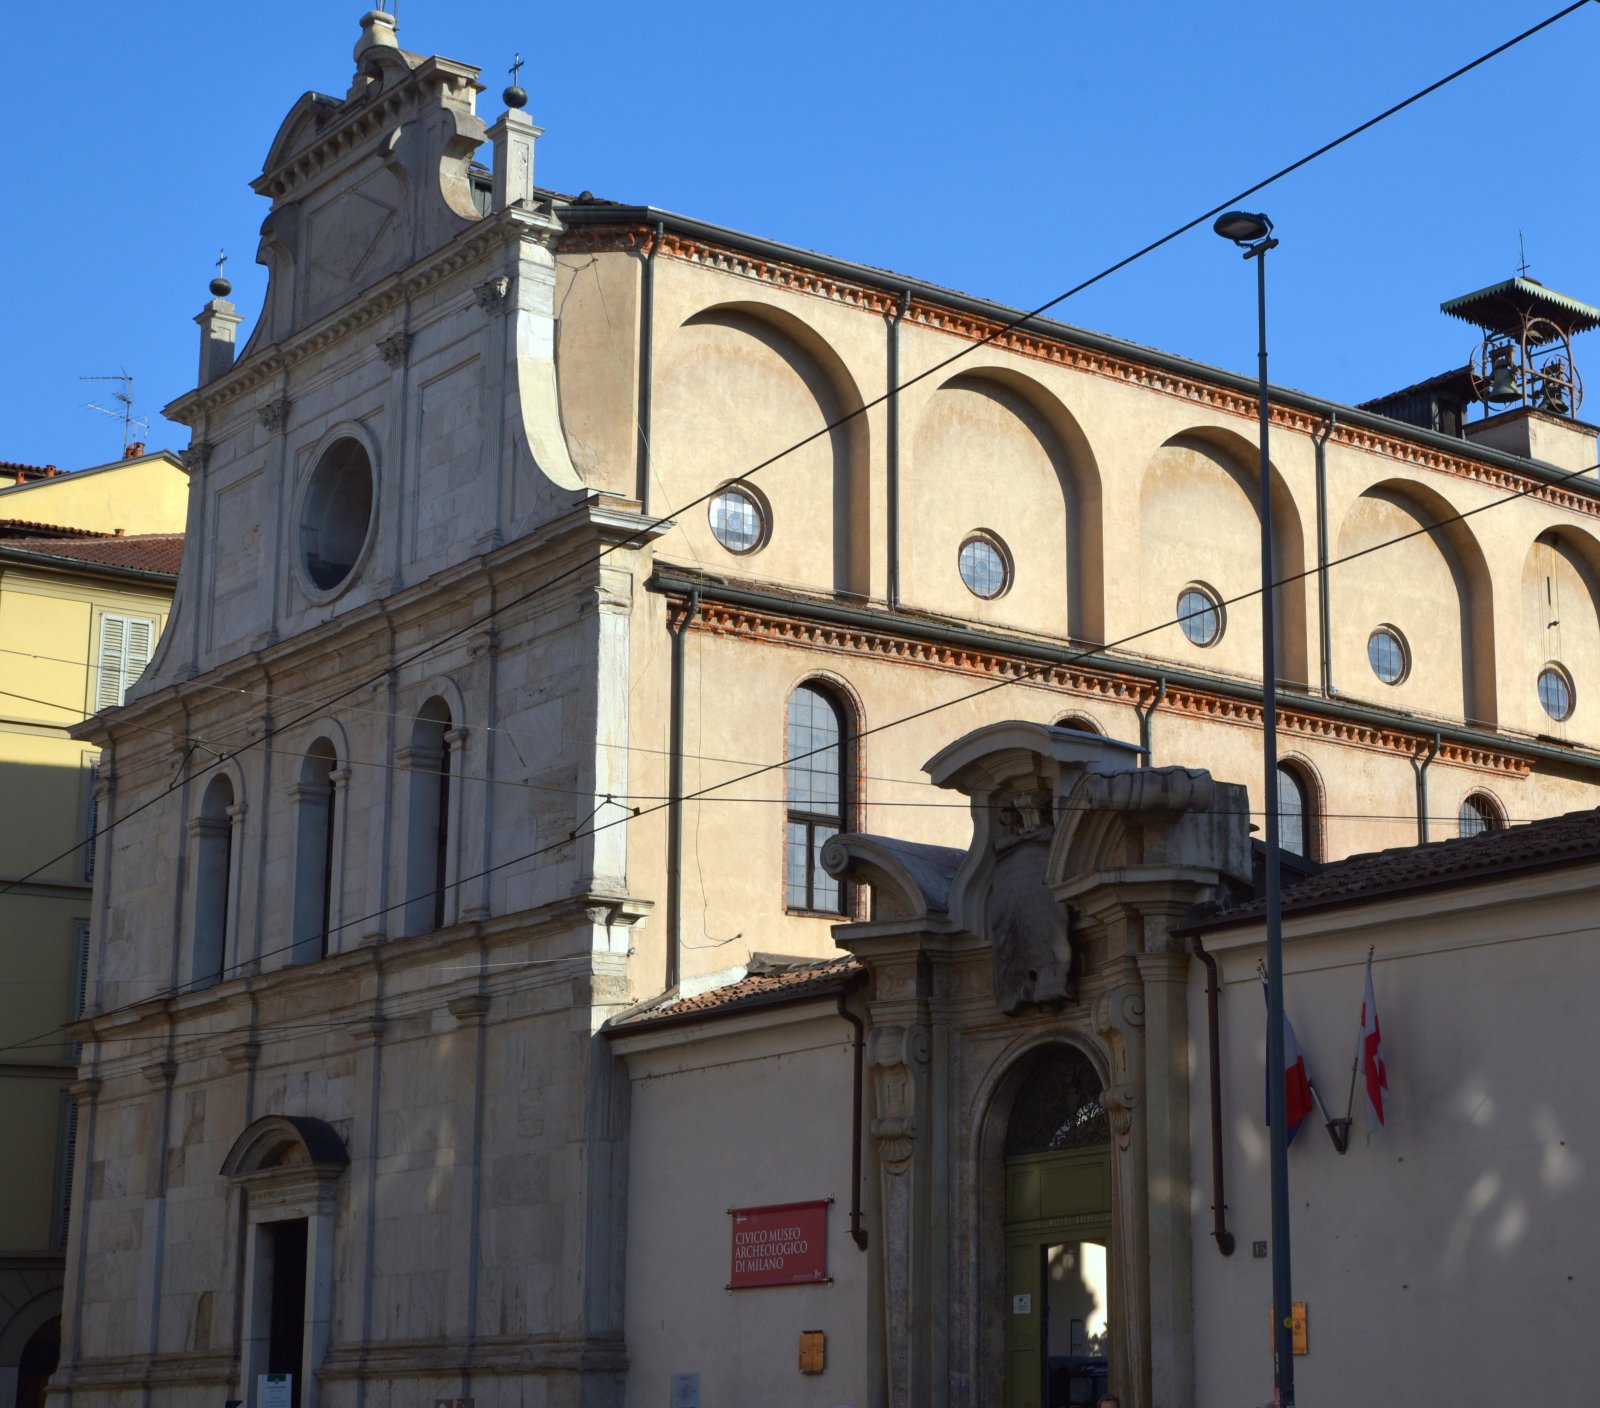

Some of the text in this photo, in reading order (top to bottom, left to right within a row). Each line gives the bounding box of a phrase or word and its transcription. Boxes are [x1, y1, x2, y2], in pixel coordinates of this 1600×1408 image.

[735, 1227, 801, 1245] CIVICO MUSEO
[735, 1240, 808, 1259] ARCHEOLOGICO
[735, 1256, 784, 1273] DI MILANO
